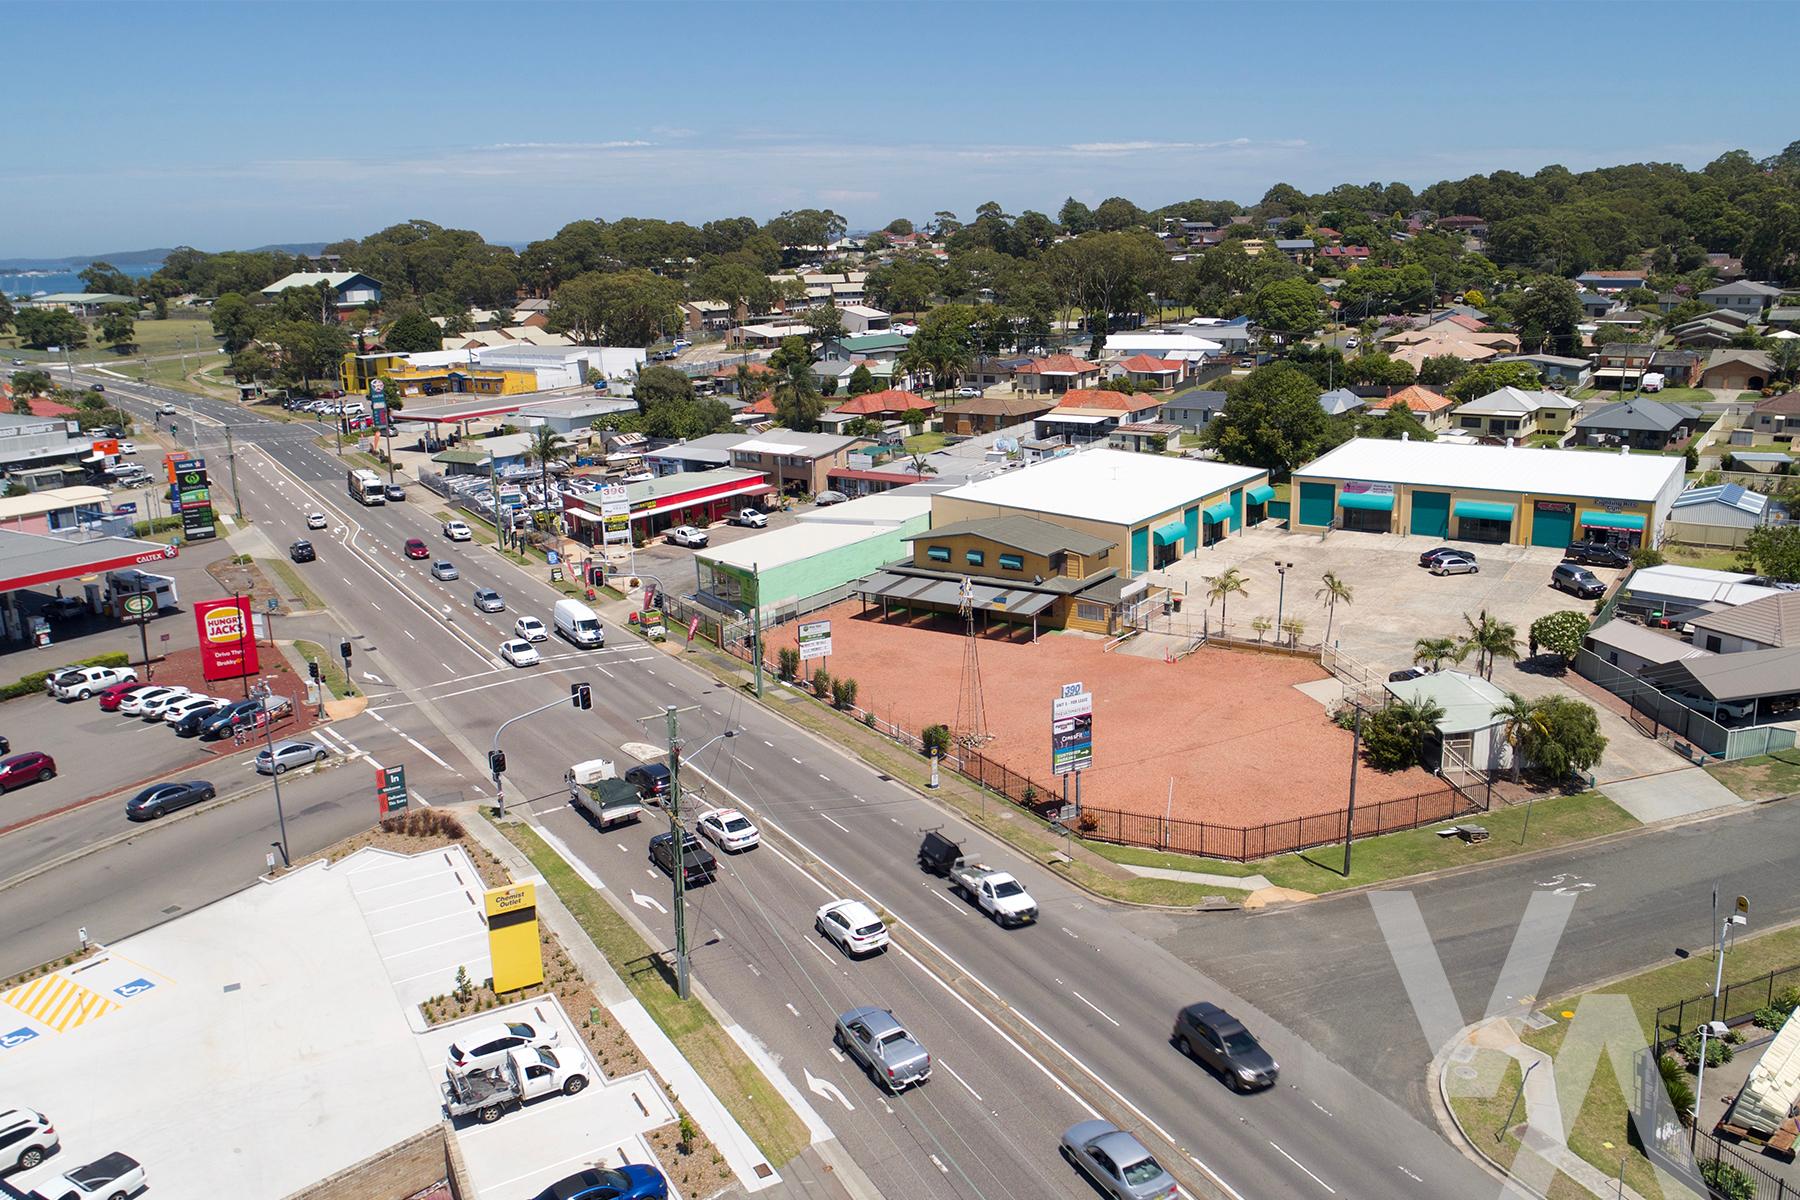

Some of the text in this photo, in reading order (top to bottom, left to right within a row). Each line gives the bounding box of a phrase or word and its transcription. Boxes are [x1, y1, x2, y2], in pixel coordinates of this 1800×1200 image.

[603, 487, 625, 496] 396
[136, 553, 162, 563] CALTEX
[1065, 684, 1081, 695] 390
[390, 775, 400, 783] In
[495, 891, 525, 903] Chemist
[499, 898, 522, 908] Outlet
